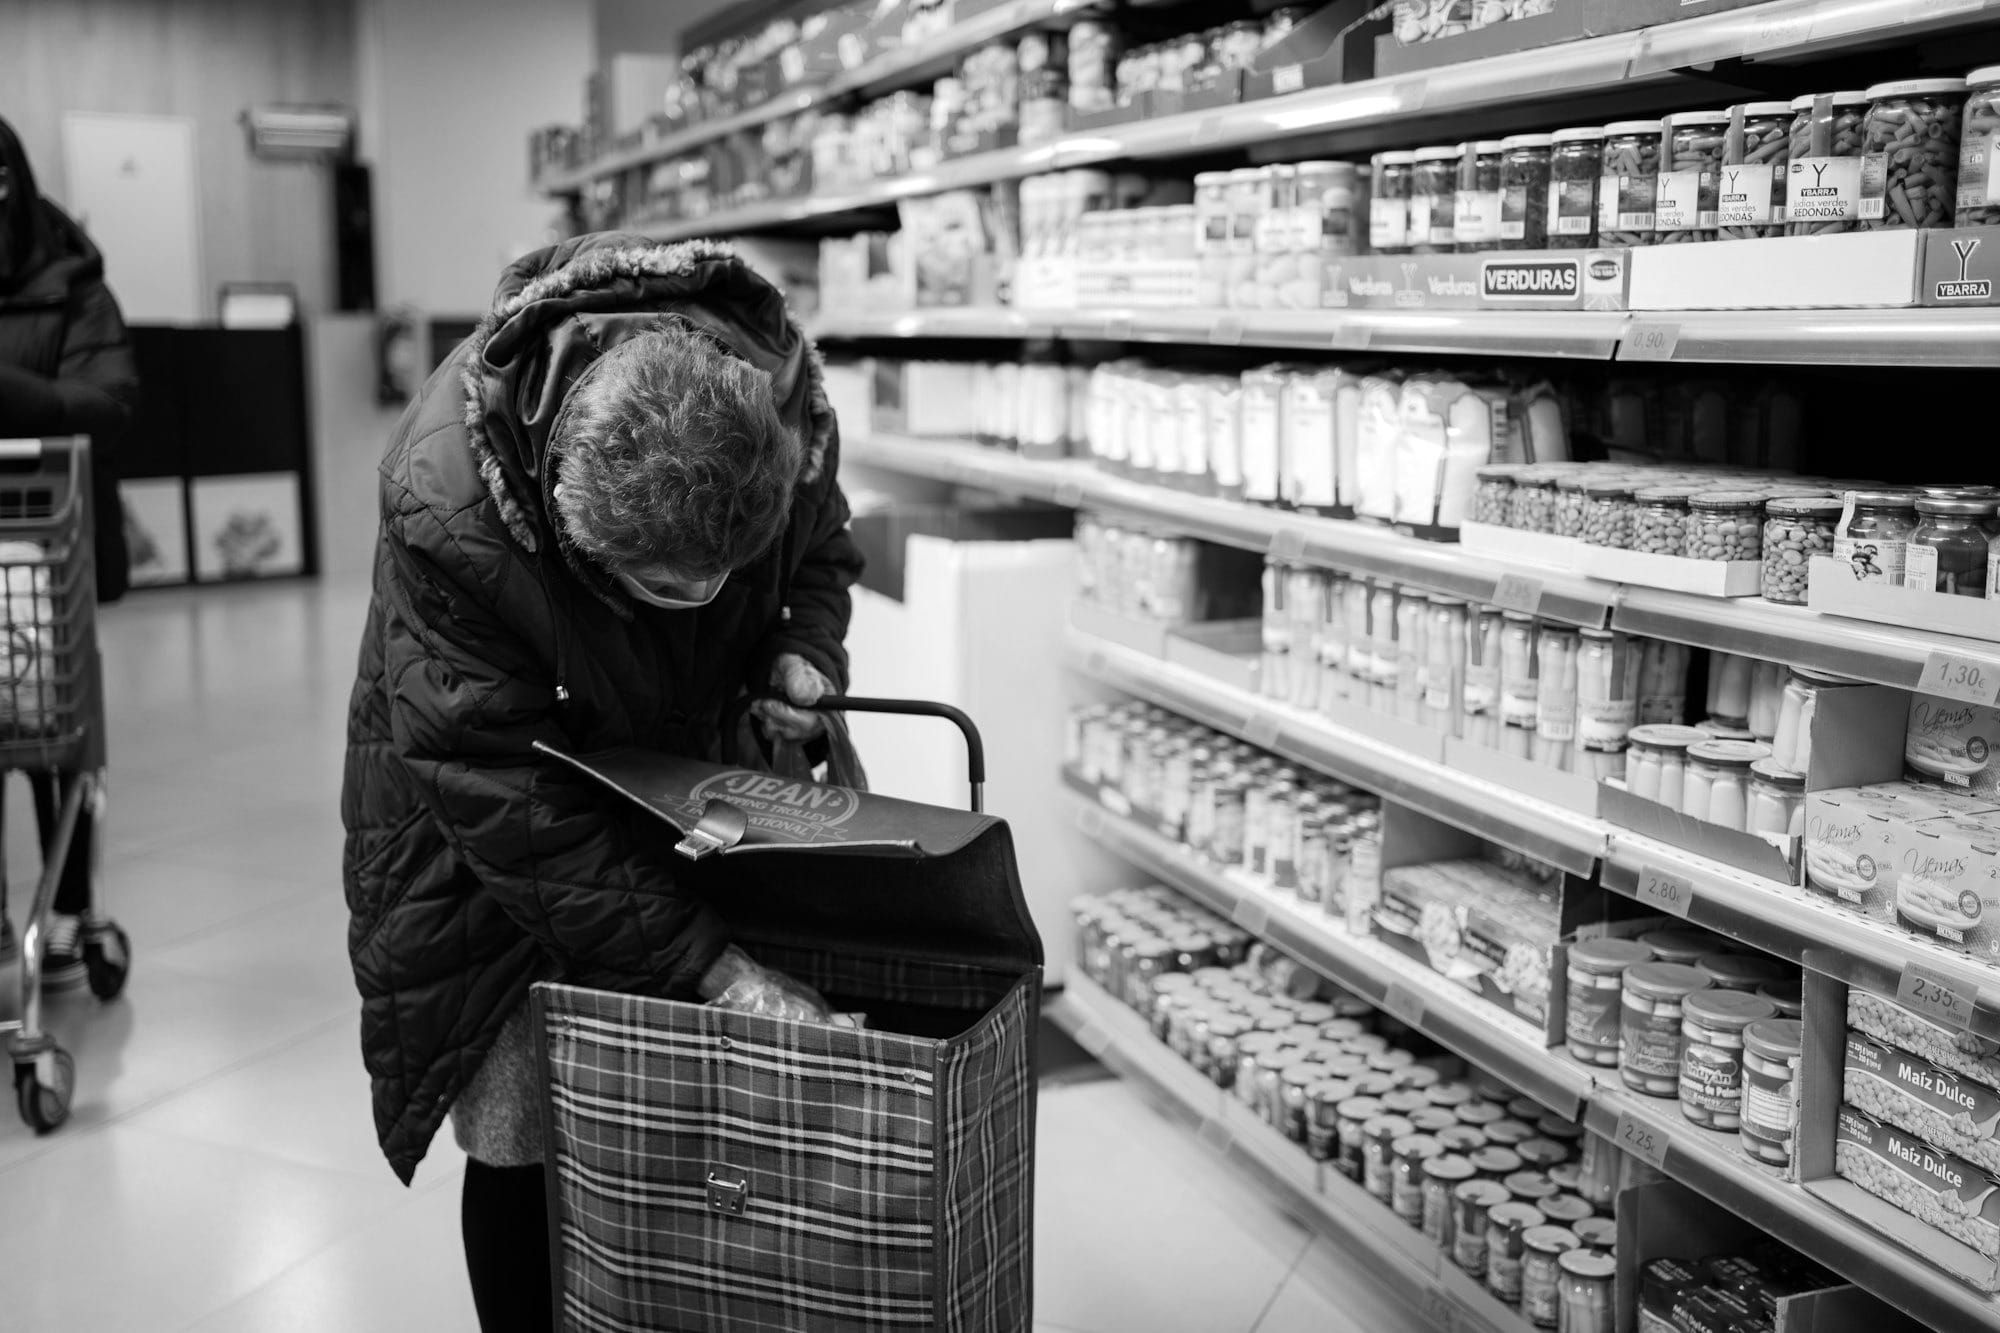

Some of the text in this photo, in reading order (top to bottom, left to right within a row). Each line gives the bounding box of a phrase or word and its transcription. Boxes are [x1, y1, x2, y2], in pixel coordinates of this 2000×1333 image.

[1728, 170, 1740, 193] Y
[1811, 163, 1829, 187] Y
[1801, 188, 1837, 196] YBARRA
[1817, 196, 1848, 207] verdes
[1794, 207, 1845, 217] REDONDAS
[1951, 239, 1981, 281] Y
[1486, 269, 1576, 291] VERDURAS
[1939, 283, 1987, 296] YBARRA
[727, 775, 836, 809] JEAN
[701, 790, 831, 822] SHOPPING TROLLEY
[687, 806, 809, 836] INATIONAL
[1903, 848, 1969, 880] Yemas
[1898, 1062, 1975, 1110] Maíz Dulce
[1888, 1137, 1962, 1188] Maíz Dulce
